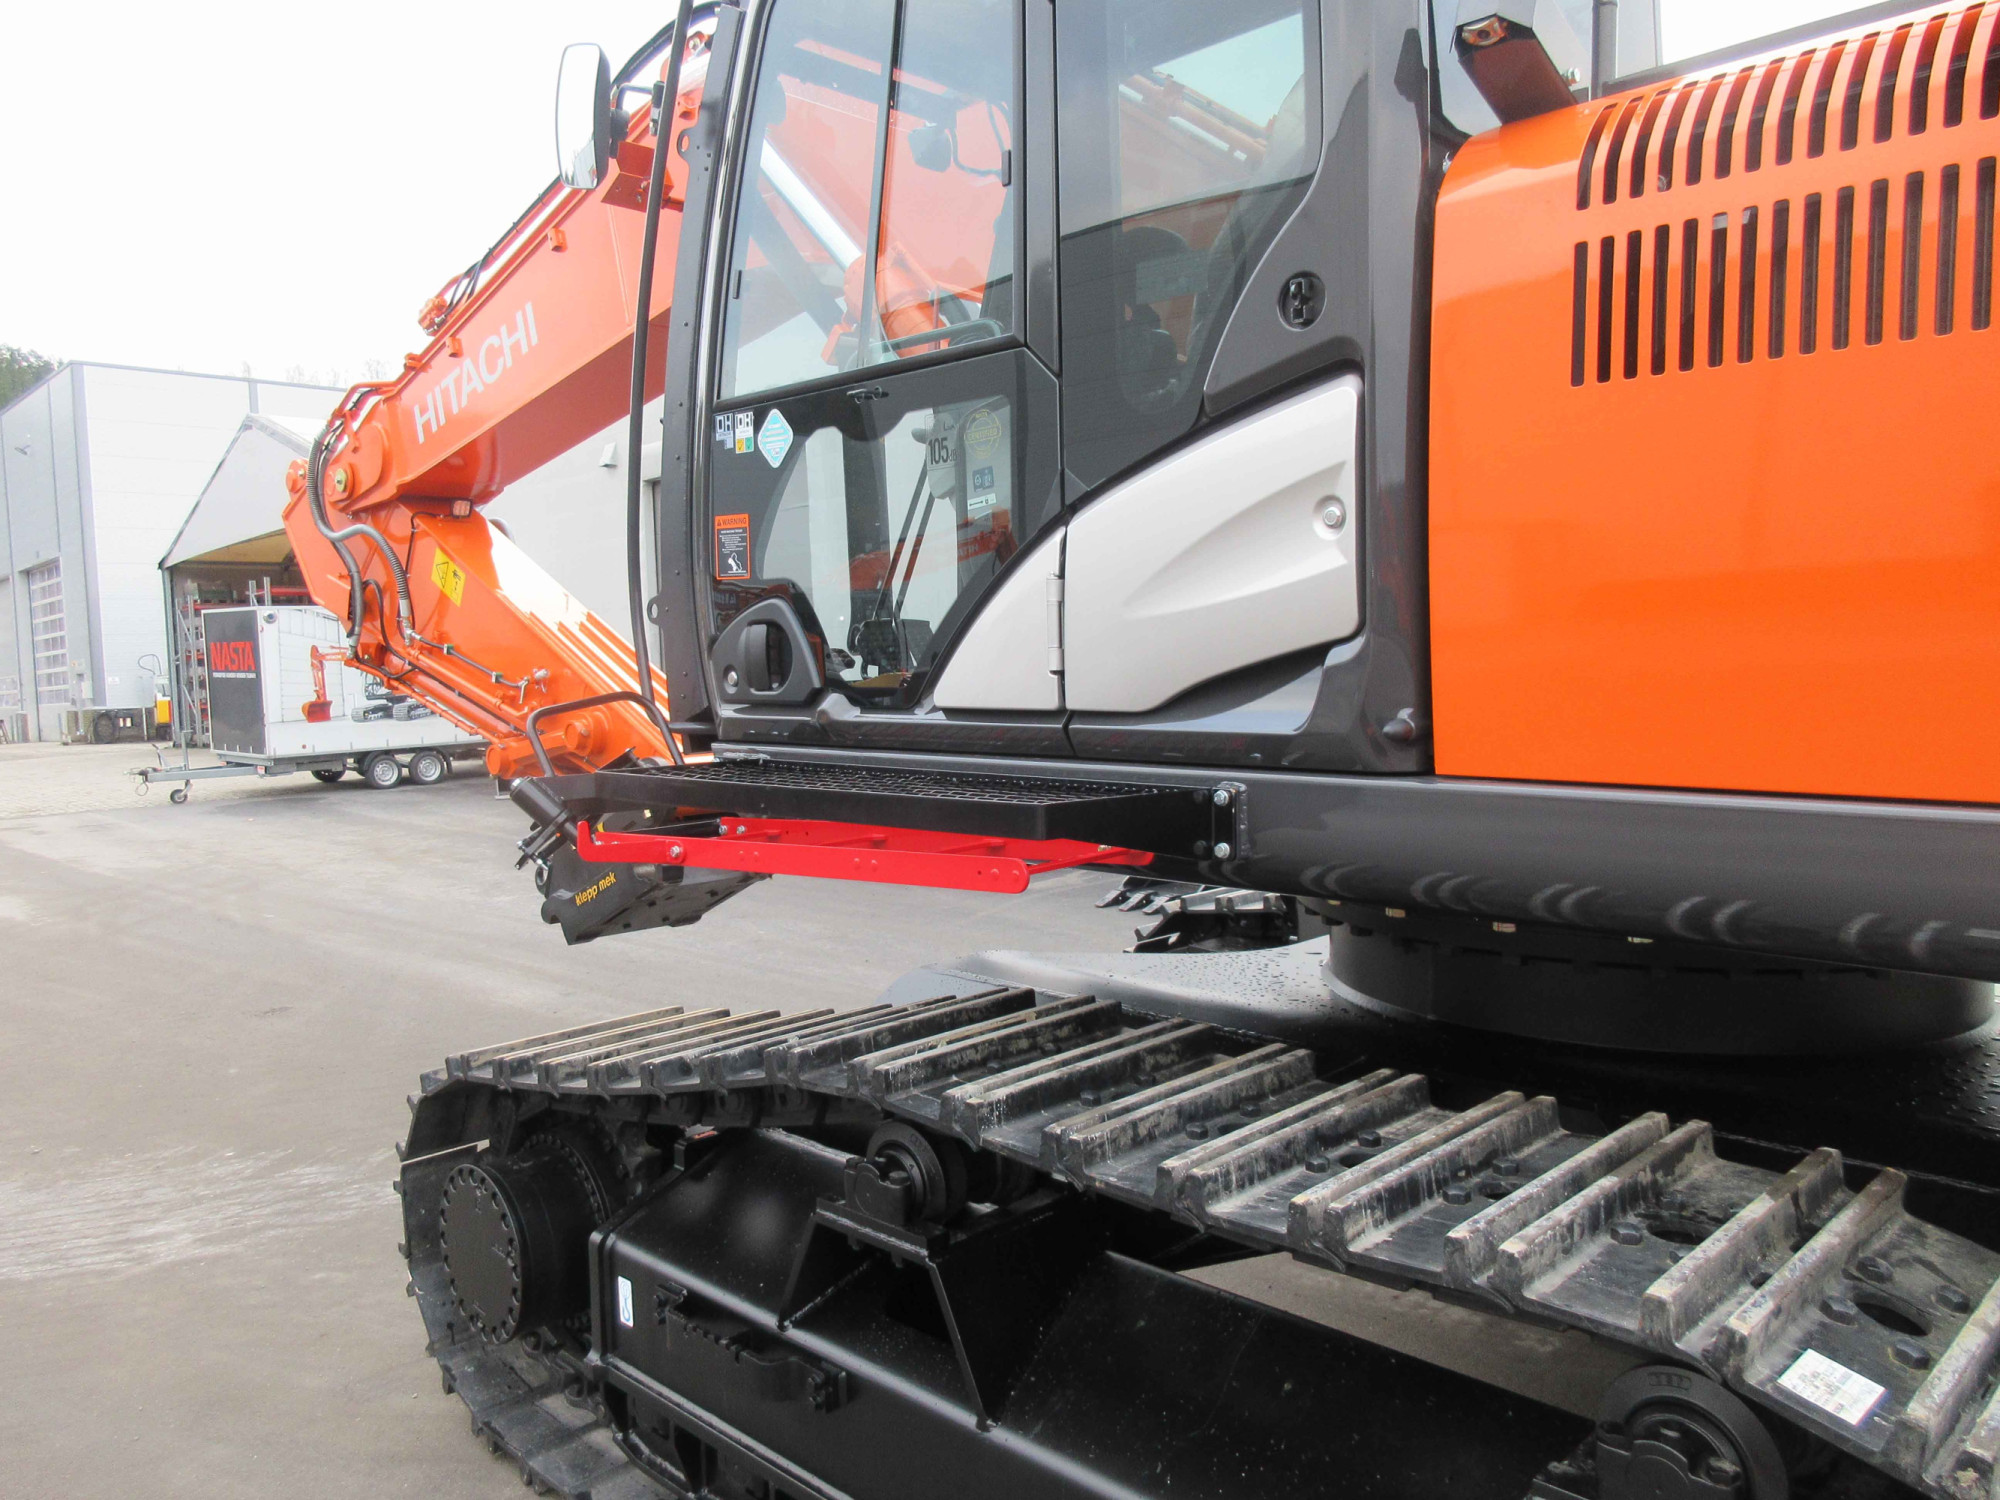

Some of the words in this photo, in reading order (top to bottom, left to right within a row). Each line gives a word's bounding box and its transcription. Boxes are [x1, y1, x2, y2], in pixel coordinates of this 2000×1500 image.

[413, 301, 539, 445] HITACHI
[928, 437, 949, 465] 105
[722, 518, 747, 526] WARNING
[210, 641, 256, 671] NASTA
[575, 885, 598, 907] klepp
[598, 872, 616, 891] mek
